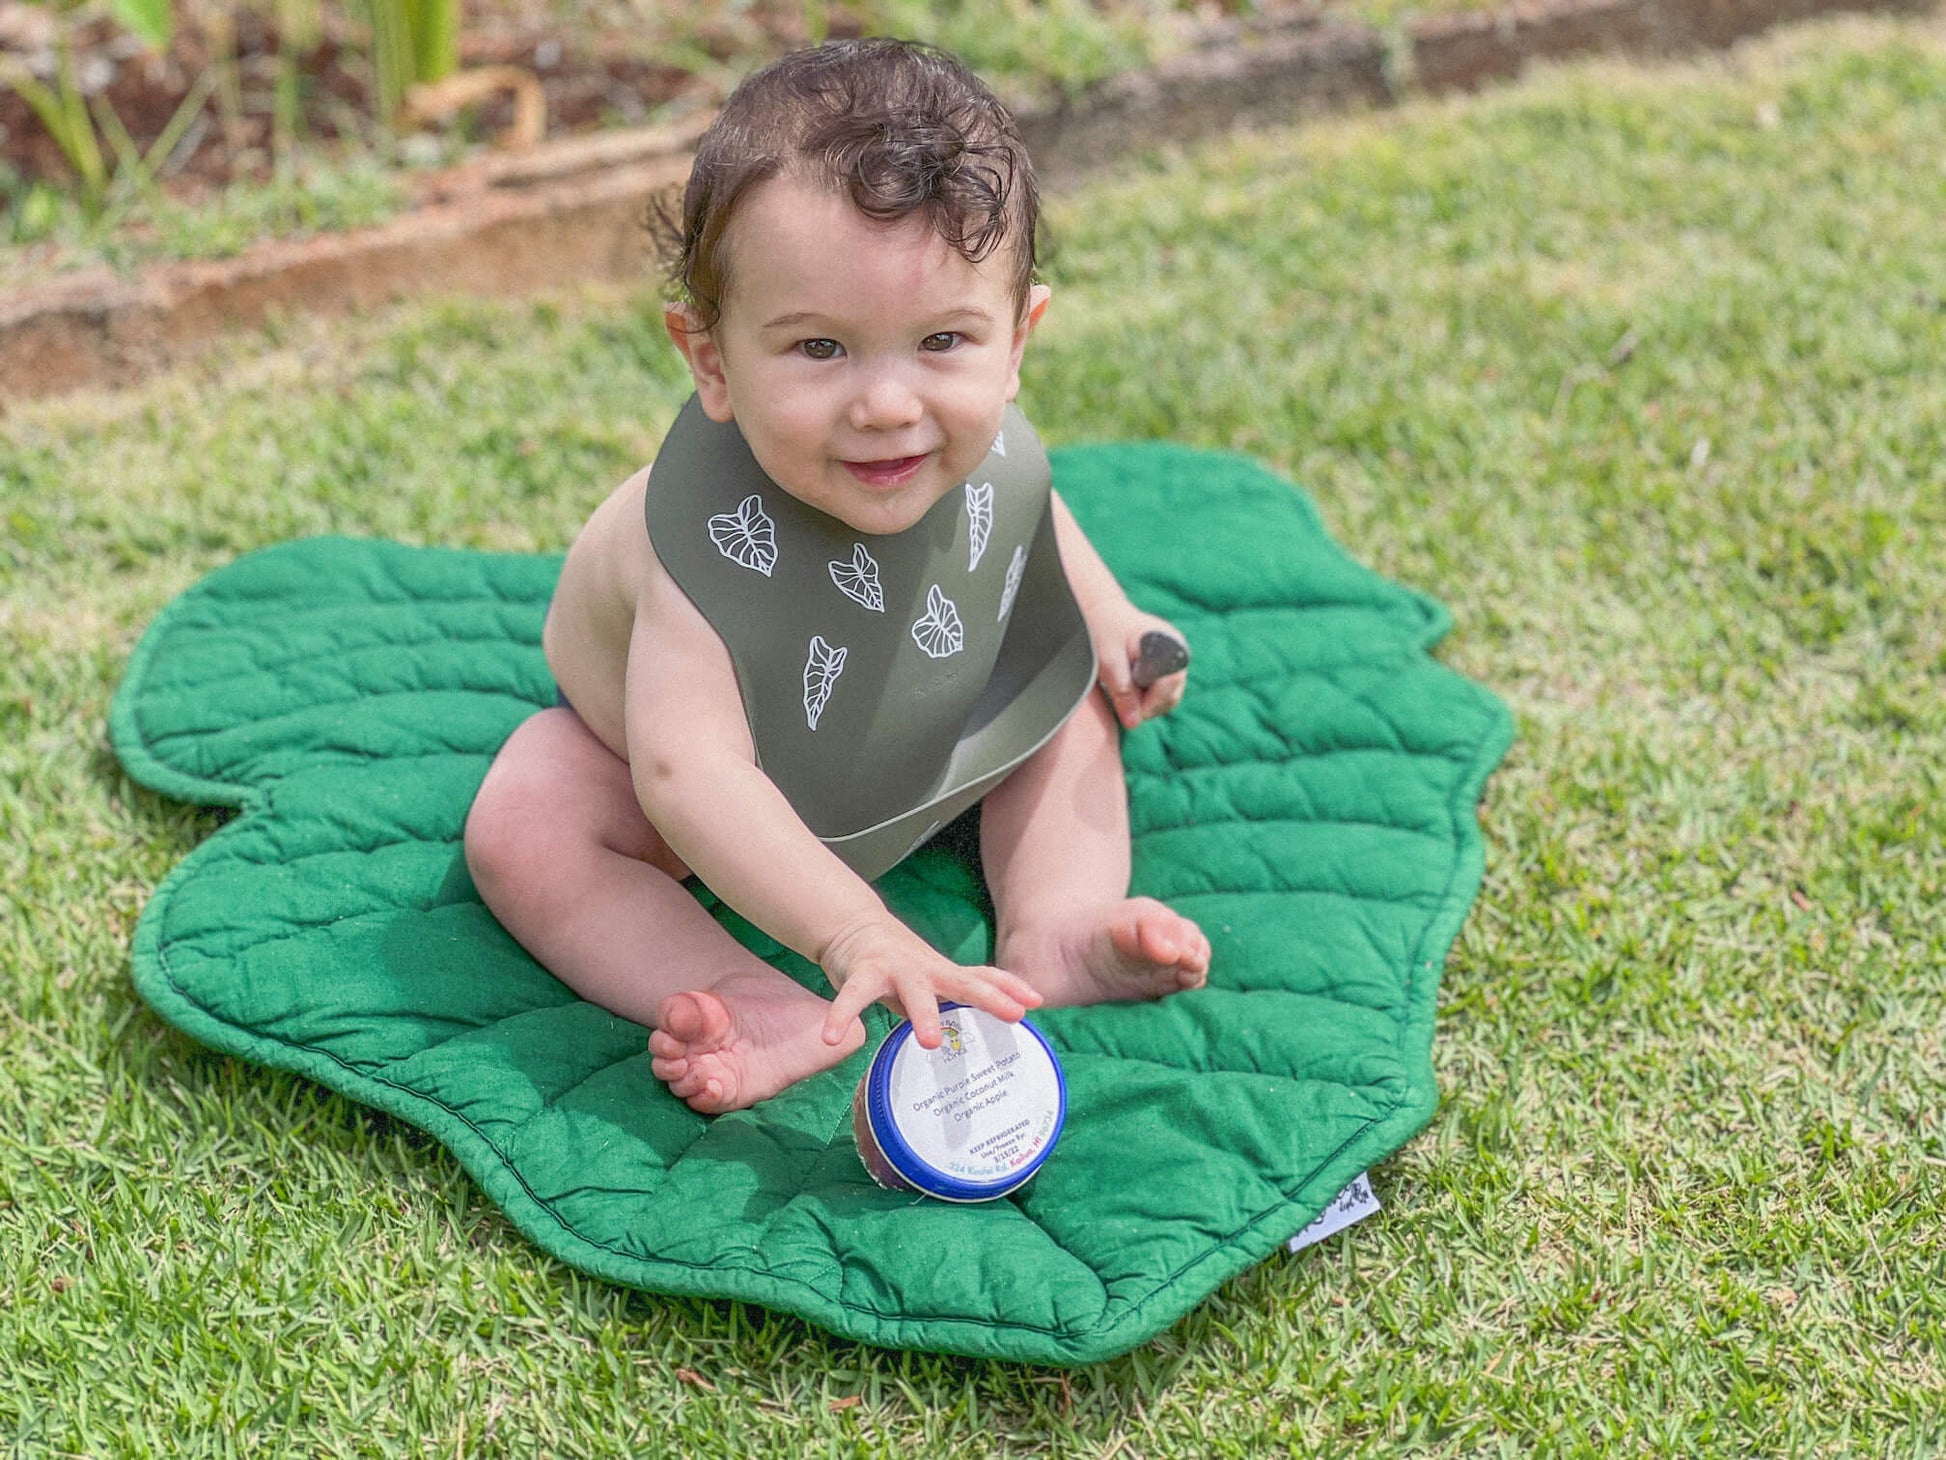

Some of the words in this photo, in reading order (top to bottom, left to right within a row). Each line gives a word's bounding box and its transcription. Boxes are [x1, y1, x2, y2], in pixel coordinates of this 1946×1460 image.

[913, 1091, 945, 1112] Organic
[944, 1078, 970, 1096] Purple
[970, 1065, 996, 1082] Sweet
[995, 1052, 1021, 1068] Potato
[933, 1096, 965, 1117] Organic
[964, 1079, 998, 1101] Coconut
[997, 1070, 1015, 1084] Milk
[954, 1102, 985, 1122] Organic
[985, 1090, 1008, 1106] Apple
[969, 1143, 985, 1155] KEEP
[986, 1119, 1031, 1146] REFRIGERATED
[994, 1145, 1020, 1163] 3/15/22
[1033, 1136, 1043, 1149] HI
